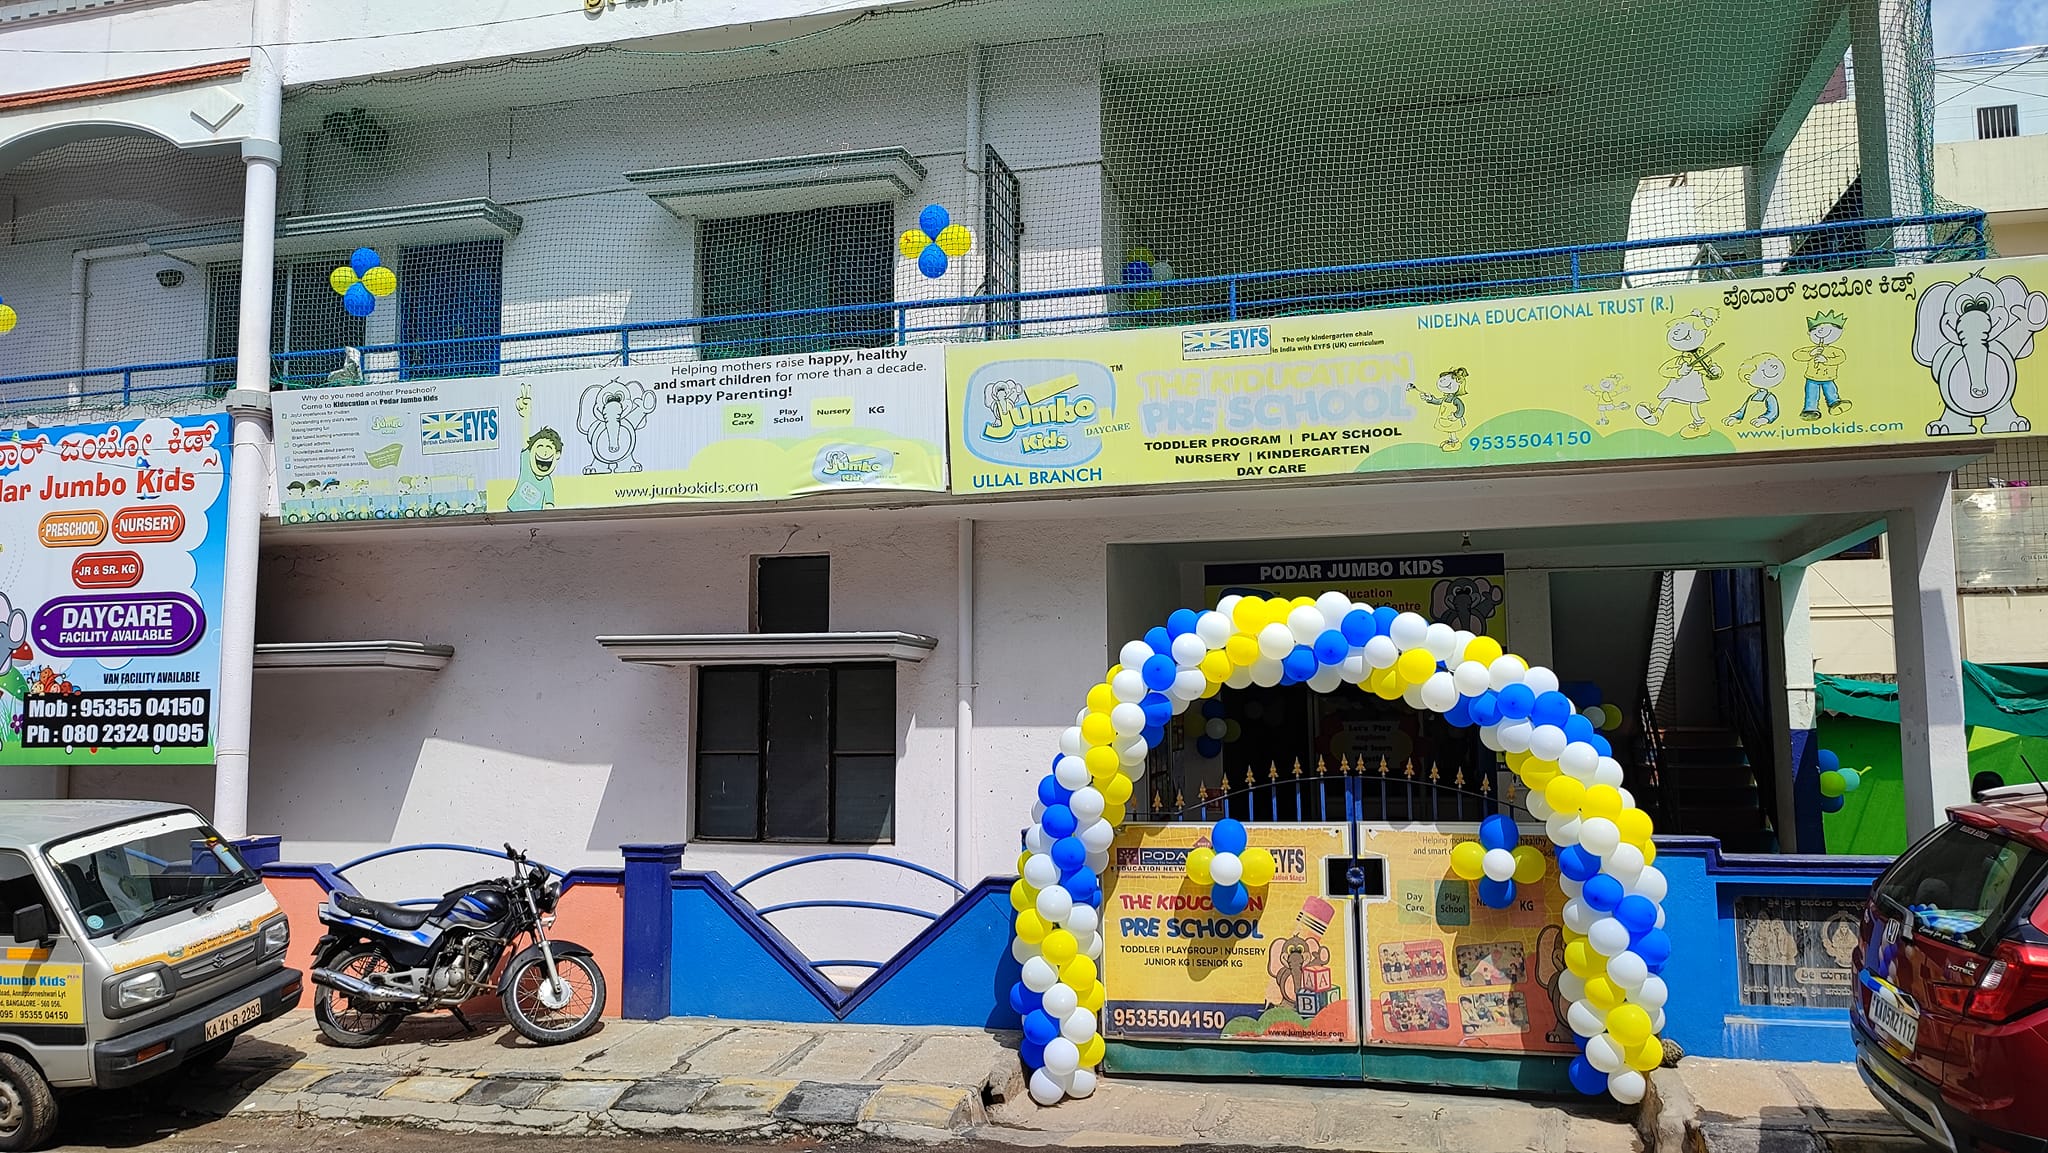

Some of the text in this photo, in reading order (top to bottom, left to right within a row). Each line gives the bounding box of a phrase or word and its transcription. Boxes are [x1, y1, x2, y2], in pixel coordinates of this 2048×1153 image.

[1723, 271, 1917, 310] ಪೊದಾರ್ ಜಂಬೋ ಕಿಡ್ಸ್
[1417, 295, 1675, 330] NIDEJNA EDUCATIONAL TRUST (R.)
[1230, 327, 1270, 350] EYFS
[1295, 335, 1310, 343] only
[1311, 332, 1354, 343] kindergarten
[1354, 330, 1374, 338] chain
[1297, 344, 1312, 352] with
[1313, 342, 1331, 351] EYFS
[1332, 341, 1348, 350] (UK)
[1348, 338, 1385, 348] curriculum
[670, 348, 908, 377] Helping mothers raise happy, healthy
[653, 361, 927, 391] and smart children for more than a decade.
[1141, 356, 1411, 398] THE KIDUCATION
[330, 393, 344, 401] you
[365, 389, 394, 397] another
[395, 386, 437, 395] Preschool?
[400, 396, 423, 404] Jumbo
[423, 394, 439, 402] Kids
[666, 387, 793, 406] Happy Parenting!
[982, 364, 1124, 440] Jumbo TM
[1143, 385, 1413, 434] PRE SCHOOL
[733, 412, 753, 421] Day
[779, 408, 799, 417] Play
[816, 407, 851, 417] Nursery
[868, 406, 885, 415] KG
[463, 409, 498, 442] EYFS
[731, 418, 755, 427] Care
[773, 415, 804, 424] School
[1085, 422, 1131, 436] DAYCARE
[1737, 420, 1904, 440] www.jumbokids.com
[60, 424, 218, 467] ಜಂಬೋ ಕಿಡ್ಸ್
[1022, 430, 1069, 454] Kids
[1144, 427, 1402, 451] TODDLER PROGRAM PLAY SCHOOL
[1469, 430, 1592, 451] 9535504150
[1175, 444, 1370, 465] NURSERY KINDERGARTEN
[972, 467, 1102, 488] ULLAL BRANCH
[1236, 463, 1307, 477] DAY CARE
[39, 467, 196, 501] Jumbo Kids
[614, 481, 759, 500] www.jumbokids.com
[45, 519, 99, 538] PRESCHOOL
[119, 513, 177, 533] NURSERY
[78, 564, 136, 576] JR & SR. KG
[1260, 559, 1444, 581] PODAR JUMBO KIDS
[62, 603, 173, 630] DAYCARE
[59, 628, 173, 644] FACILITY AVAILABLE
[103, 671, 200, 685] VAN FACILITY AVAILABLE
[29, 699, 69, 719] Mob
[80, 697, 142, 717] 95355
[146, 695, 205, 716] 04150
[27, 726, 50, 744] Ph
[62, 724, 99, 744] 080
[102, 723, 150, 743] 2324
[152, 722, 204, 742] 0095
[1422, 836, 1547, 847] Helping healthy
[1142, 851, 1191, 861] PODA
[1413, 846, 1448, 855] and smart
[1119, 894, 1153, 911] THE
[1406, 892, 1423, 903] Day
[1444, 893, 1461, 903] Play
[1519, 900, 1534, 911] KG
[1405, 903, 1425, 912] Care
[1440, 903, 1466, 913] School
[1120, 917, 1264, 940] PRE SCHOOL
[1120, 945, 1266, 956] TODDLER PLAYGROUP NURSERY
[1144, 957, 1243, 968] JUNIOR KG SENIOR KG
[0, 976, 66, 987] Jumbo Kids
[57, 990, 67, 999] Lyt
[1302, 996, 1313, 1011] B
[20, 1010, 43, 1019] 95355
[45, 1010, 69, 1020] 04150
[206, 1003, 261, 1039] KA 41 B 2293
[1113, 1007, 1225, 1030] 9535504150
[1267, 1028, 1345, 1039] www.jumbokids.com
